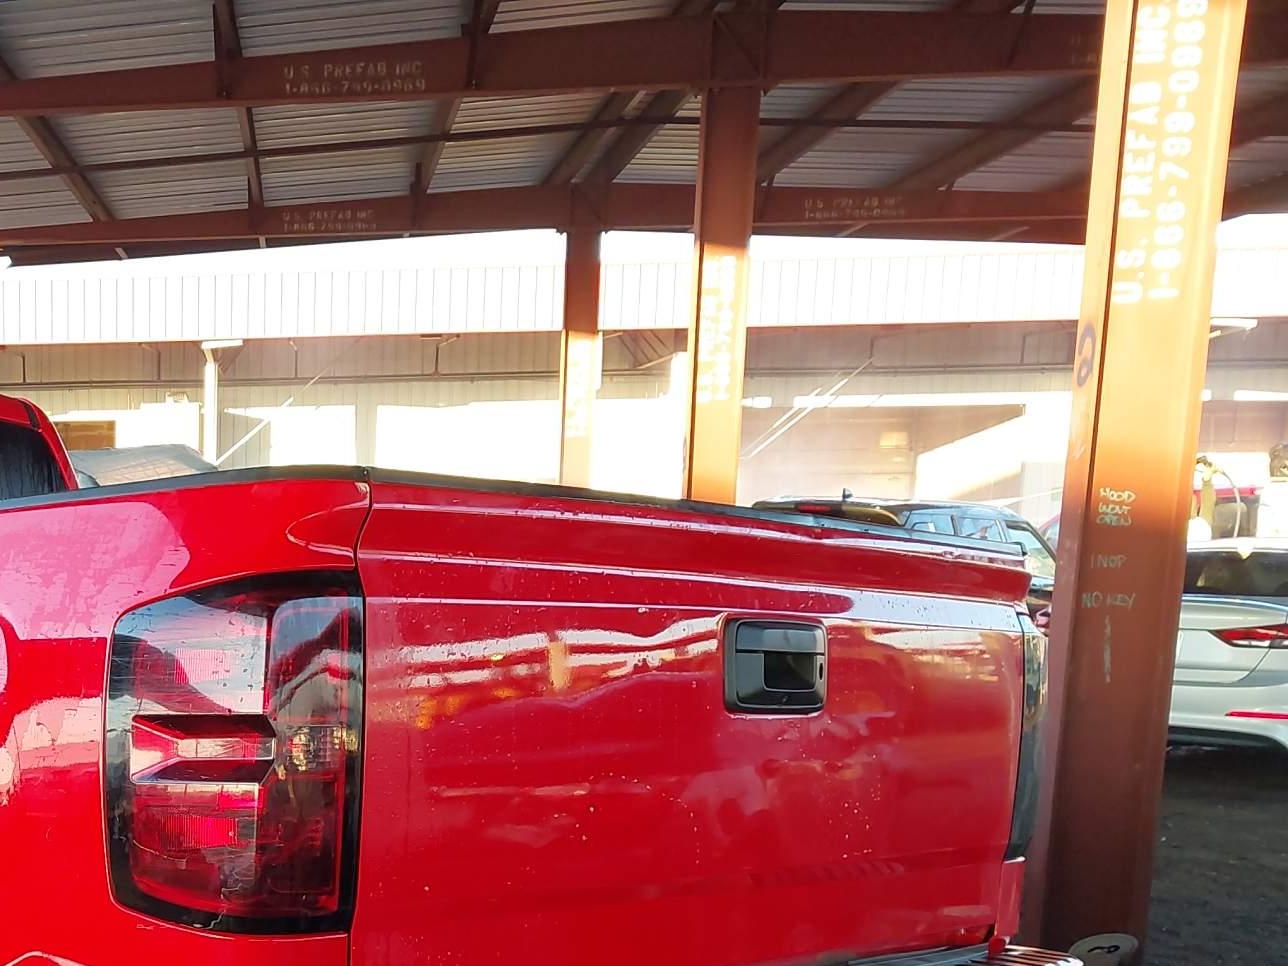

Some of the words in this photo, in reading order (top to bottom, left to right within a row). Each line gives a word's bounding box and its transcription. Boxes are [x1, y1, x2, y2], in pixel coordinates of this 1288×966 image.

[1120, 82, 1163, 219] PREFAB
[1099, 487, 1136, 503] HOOD
[1081, 591, 1103, 609] NO
[1106, 592, 1136, 610] KEY
